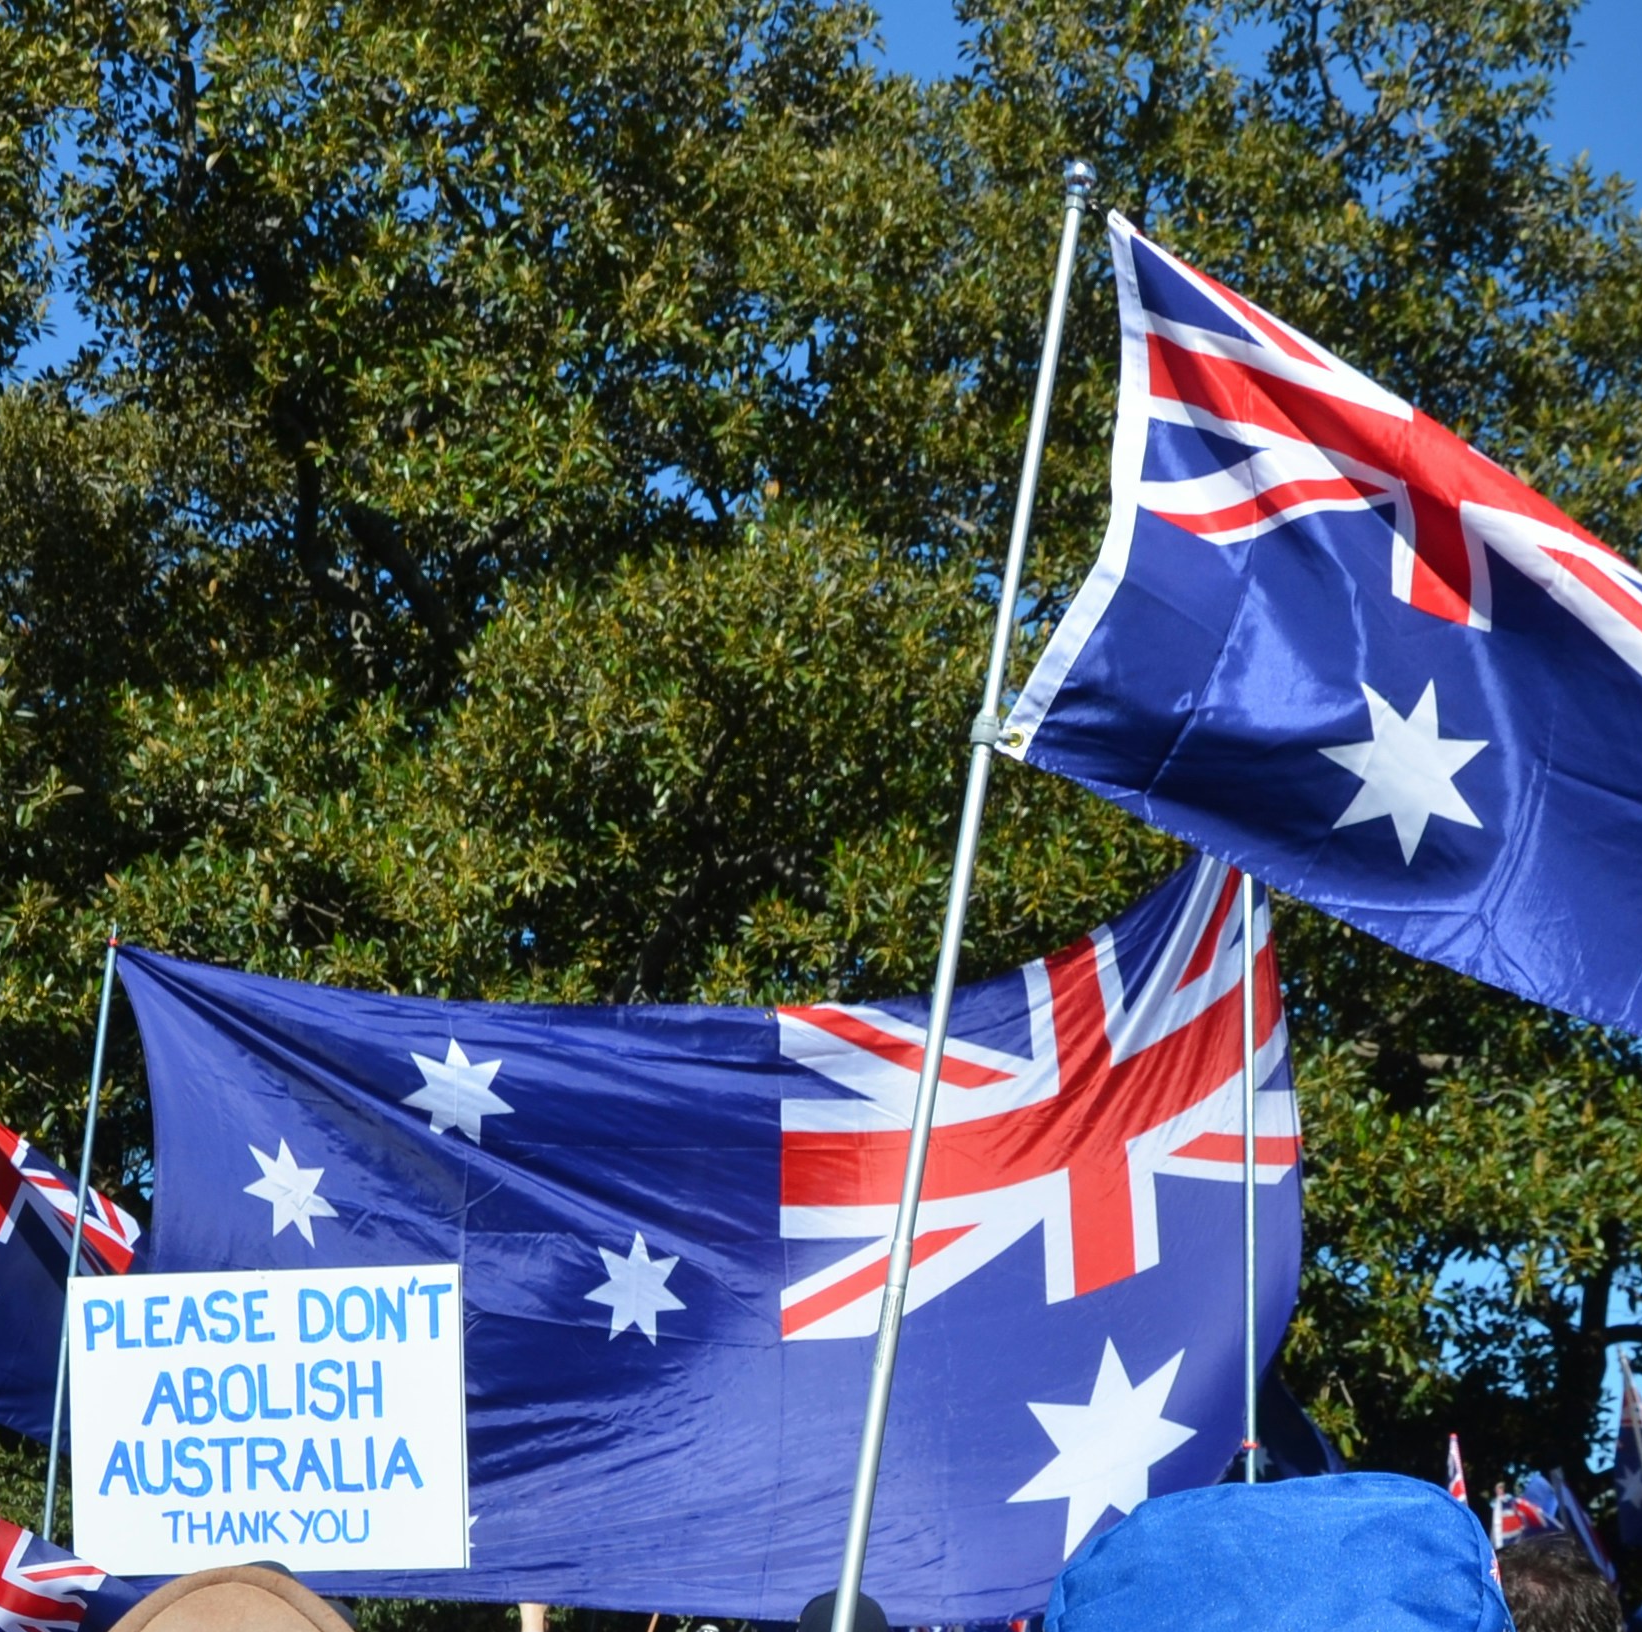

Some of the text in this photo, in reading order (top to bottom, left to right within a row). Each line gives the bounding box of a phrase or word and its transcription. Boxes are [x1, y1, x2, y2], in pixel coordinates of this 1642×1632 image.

[83, 1276, 452, 1351] PLEASE DON'T
[141, 1359, 383, 1426] ABOLISH
[98, 1436, 423, 1498] AUSTRALIA
[162, 1509, 369, 1546] THANK YOU
